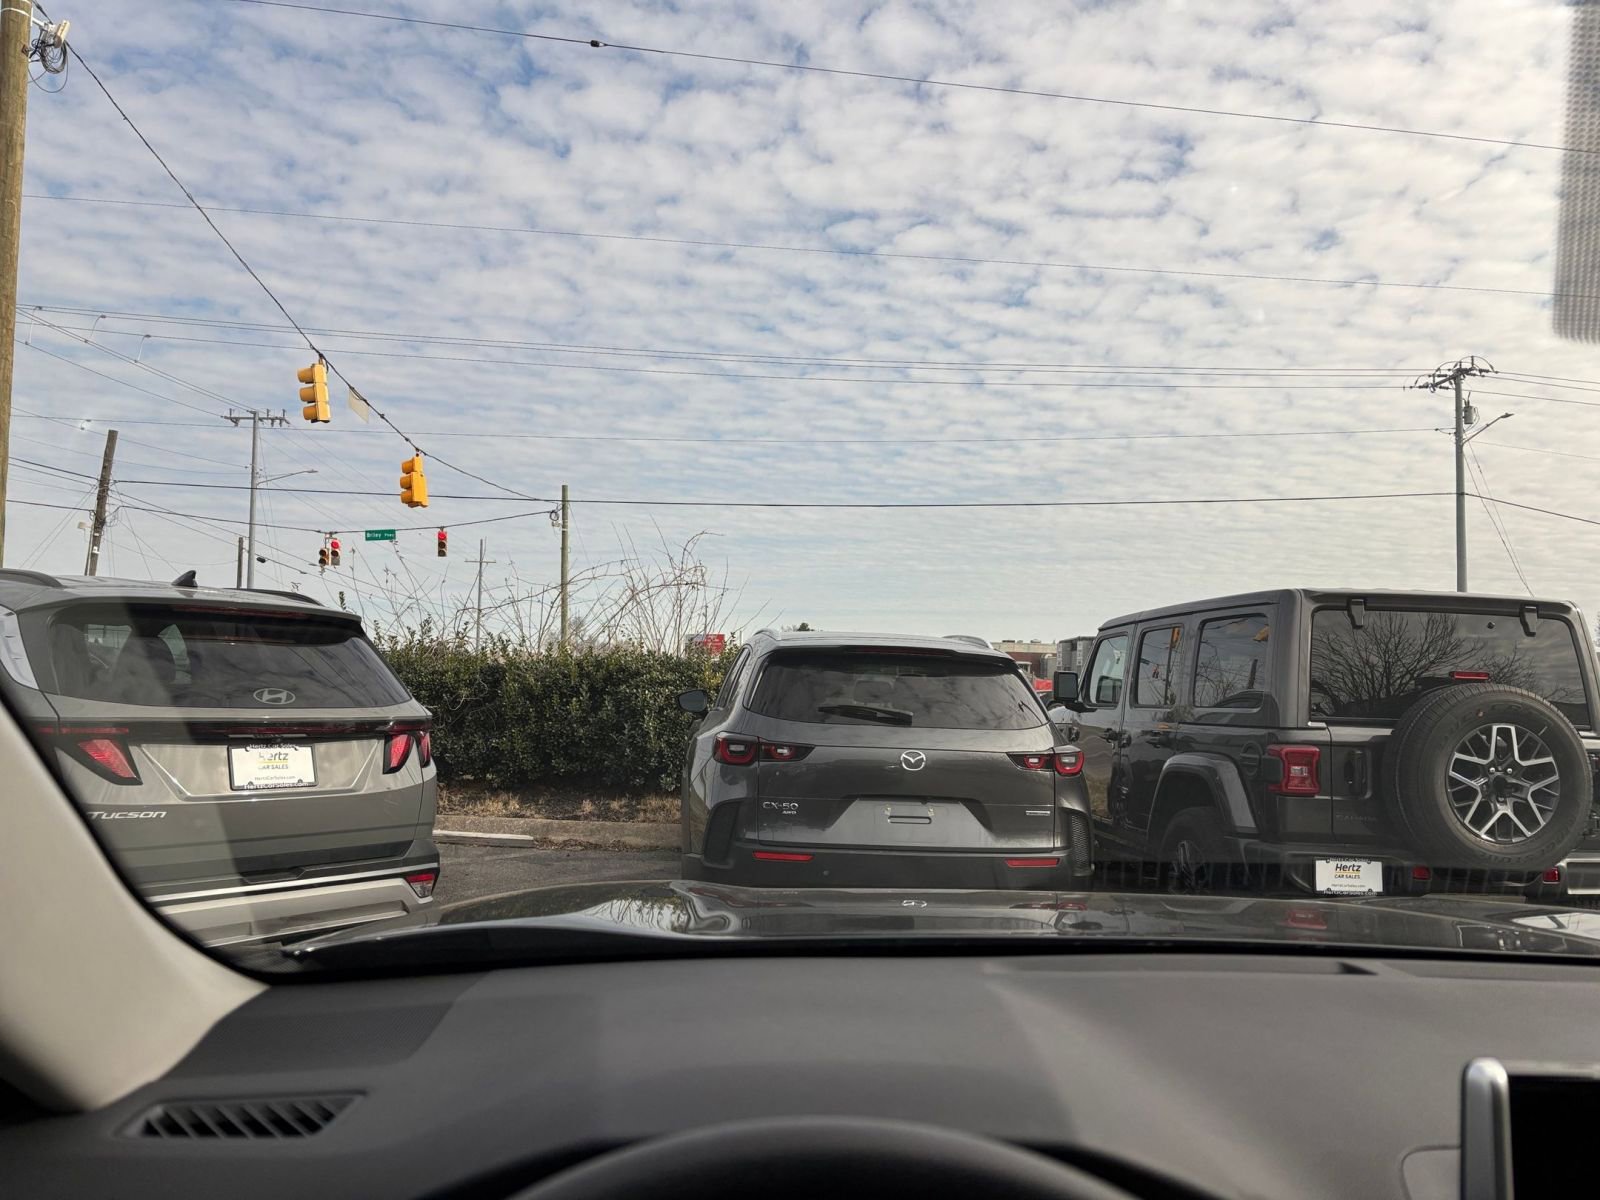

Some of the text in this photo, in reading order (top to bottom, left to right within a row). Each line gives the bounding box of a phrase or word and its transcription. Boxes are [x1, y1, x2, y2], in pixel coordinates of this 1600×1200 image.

[244, 781, 309, 790] HertzCarSales.com
[762, 801, 799, 810] CX-50
[1335, 863, 1362, 872] Hertz
